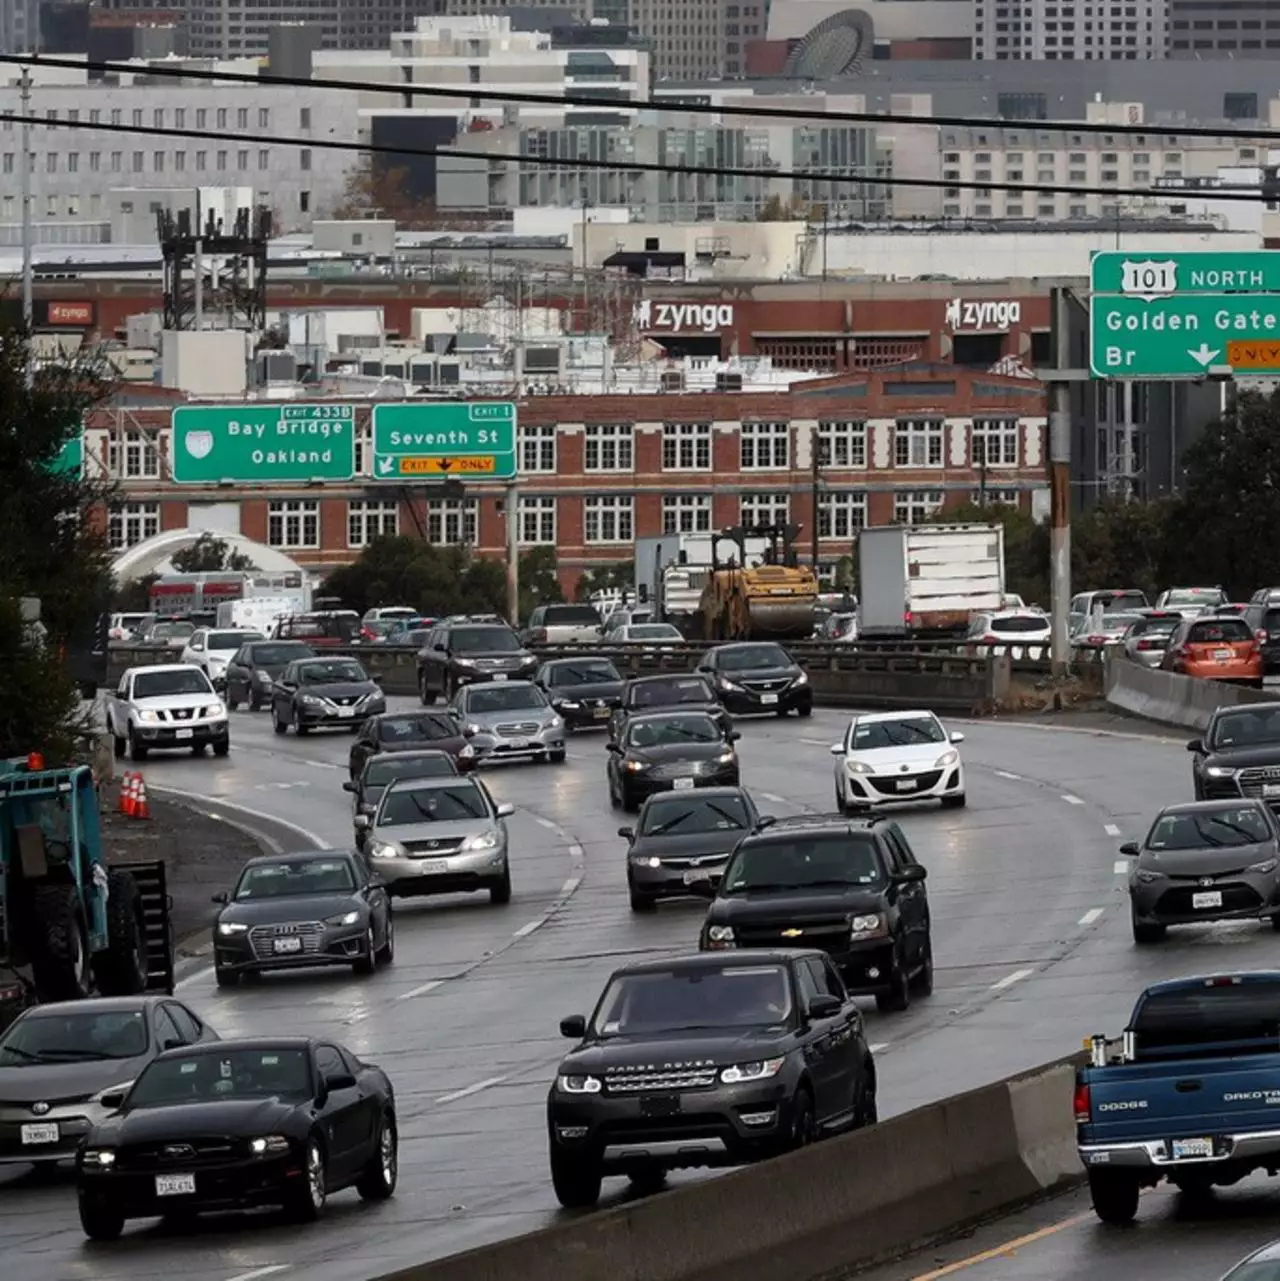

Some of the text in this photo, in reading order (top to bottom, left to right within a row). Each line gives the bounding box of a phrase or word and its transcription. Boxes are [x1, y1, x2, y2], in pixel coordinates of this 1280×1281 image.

[1131, 269, 1167, 289] 101
[1191, 270, 1264, 287] NORTH
[655, 302, 734, 332] zynga
[962, 300, 1021, 330] zynga
[1106, 310, 1278, 331] Golden Gate
[1105, 346, 1137, 367] Br
[312, 406, 351, 419] 433B
[474, 407, 498, 417] EXIT
[228, 420, 344, 438] Bay Bridge
[389, 429, 499, 446] Seventh St
[252, 450, 332, 464] Oakland
[401, 460, 428, 471] EXIT
[460, 459, 492, 470] ONLY
[1099, 1100, 1149, 1111] DODGE
